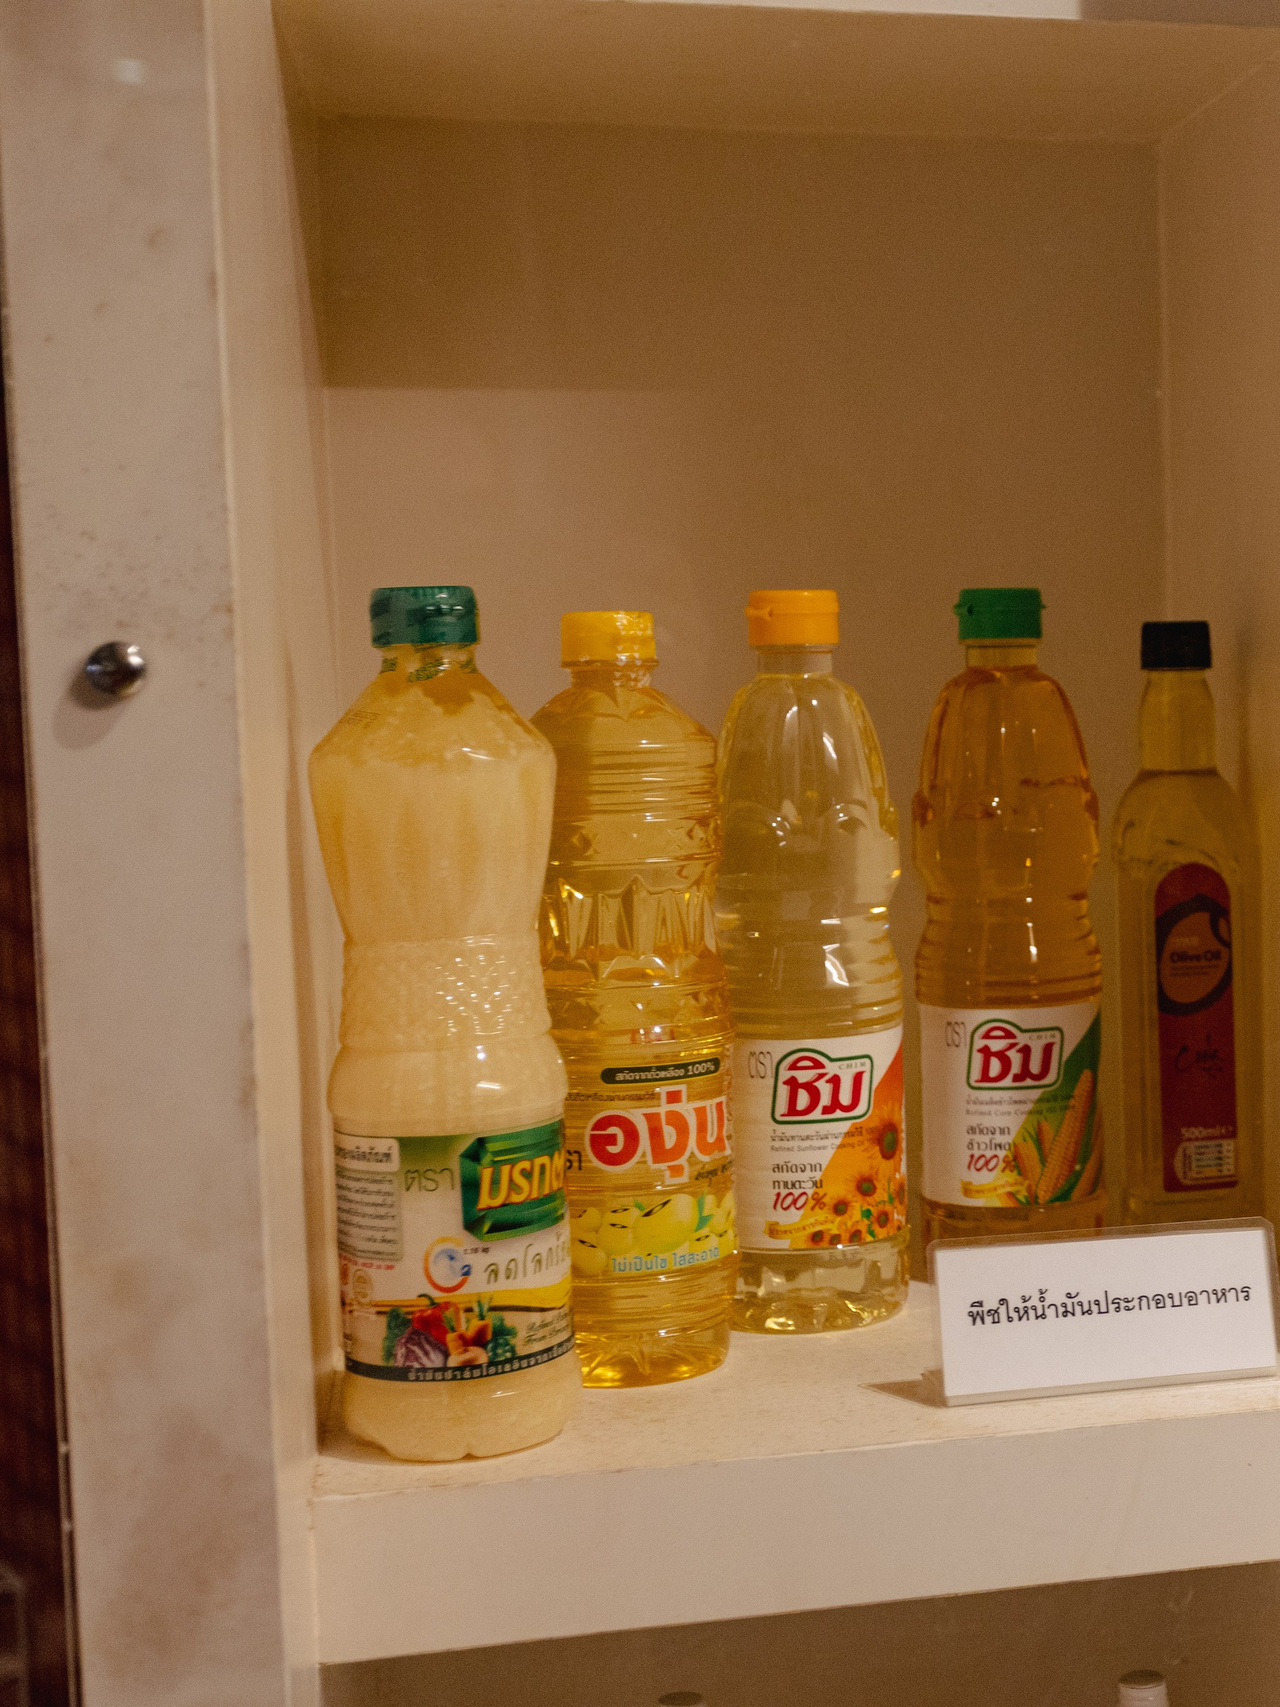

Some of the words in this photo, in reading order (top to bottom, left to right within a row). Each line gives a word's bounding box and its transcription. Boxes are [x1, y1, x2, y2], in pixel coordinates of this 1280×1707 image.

[1169, 950, 1202, 964] Olive
[1203, 949, 1222, 962] Oil
[973, 1025, 1057, 1083] ชิม
[615, 1066, 685, 1081] สกัดจากถั่วเหลือง
[686, 1061, 716, 1075] 100%
[748, 1050, 774, 1080] ตรา
[838, 1060, 867, 1071] CHIM
[779, 1054, 868, 1118] ชิม
[588, 1088, 728, 1179] องุ่น
[966, 1122, 1011, 1136] สกัดจาก
[770, 1143, 795, 1151] Refined
[797, 1143, 829, 1151] Sunflower
[966, 1136, 1012, 1151] ข้าวโพด
[772, 1160, 823, 1174] สกัดจาก
[966, 1153, 1017, 1173] 100%
[404, 1167, 455, 1192] ตรา
[772, 1177, 824, 1190] ทานตะวัน
[773, 1191, 828, 1212] 100%
[611, 1255, 668, 1273] ไม่เป็นไข
[967, 1285, 1252, 1326] พืชให้น้ำมันประกอบอาหาร
